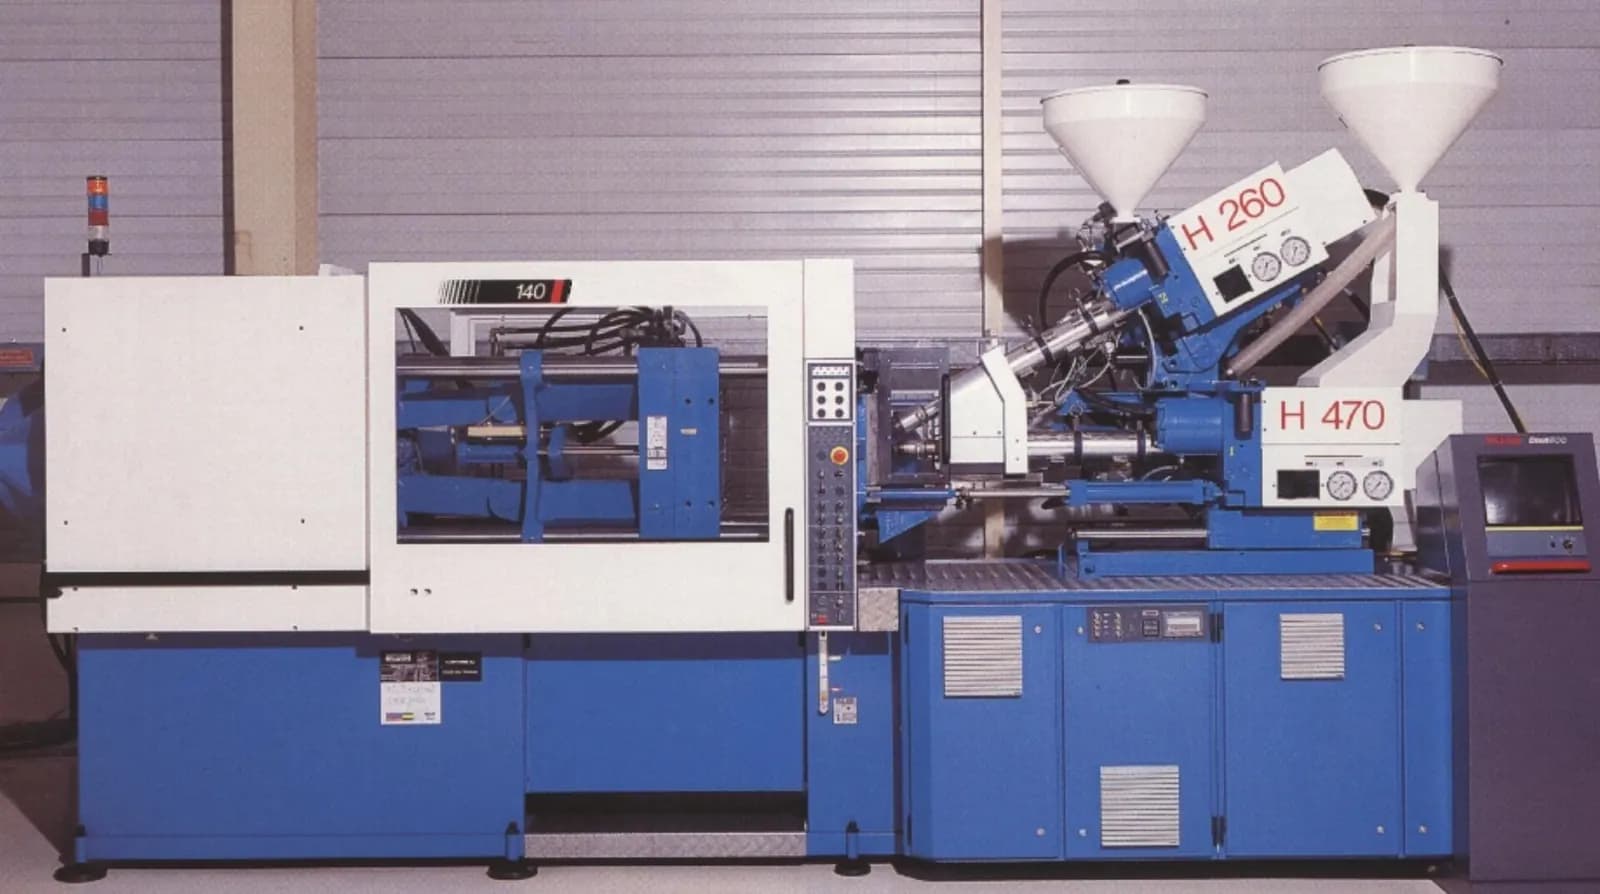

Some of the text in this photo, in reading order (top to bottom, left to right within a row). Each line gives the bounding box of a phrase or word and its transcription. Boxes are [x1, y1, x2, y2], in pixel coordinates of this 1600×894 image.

[1181, 215, 1214, 251] H
[1219, 178, 1286, 232] 260
[516, 283, 546, 300] 140
[1280, 400, 1385, 430] H 470
